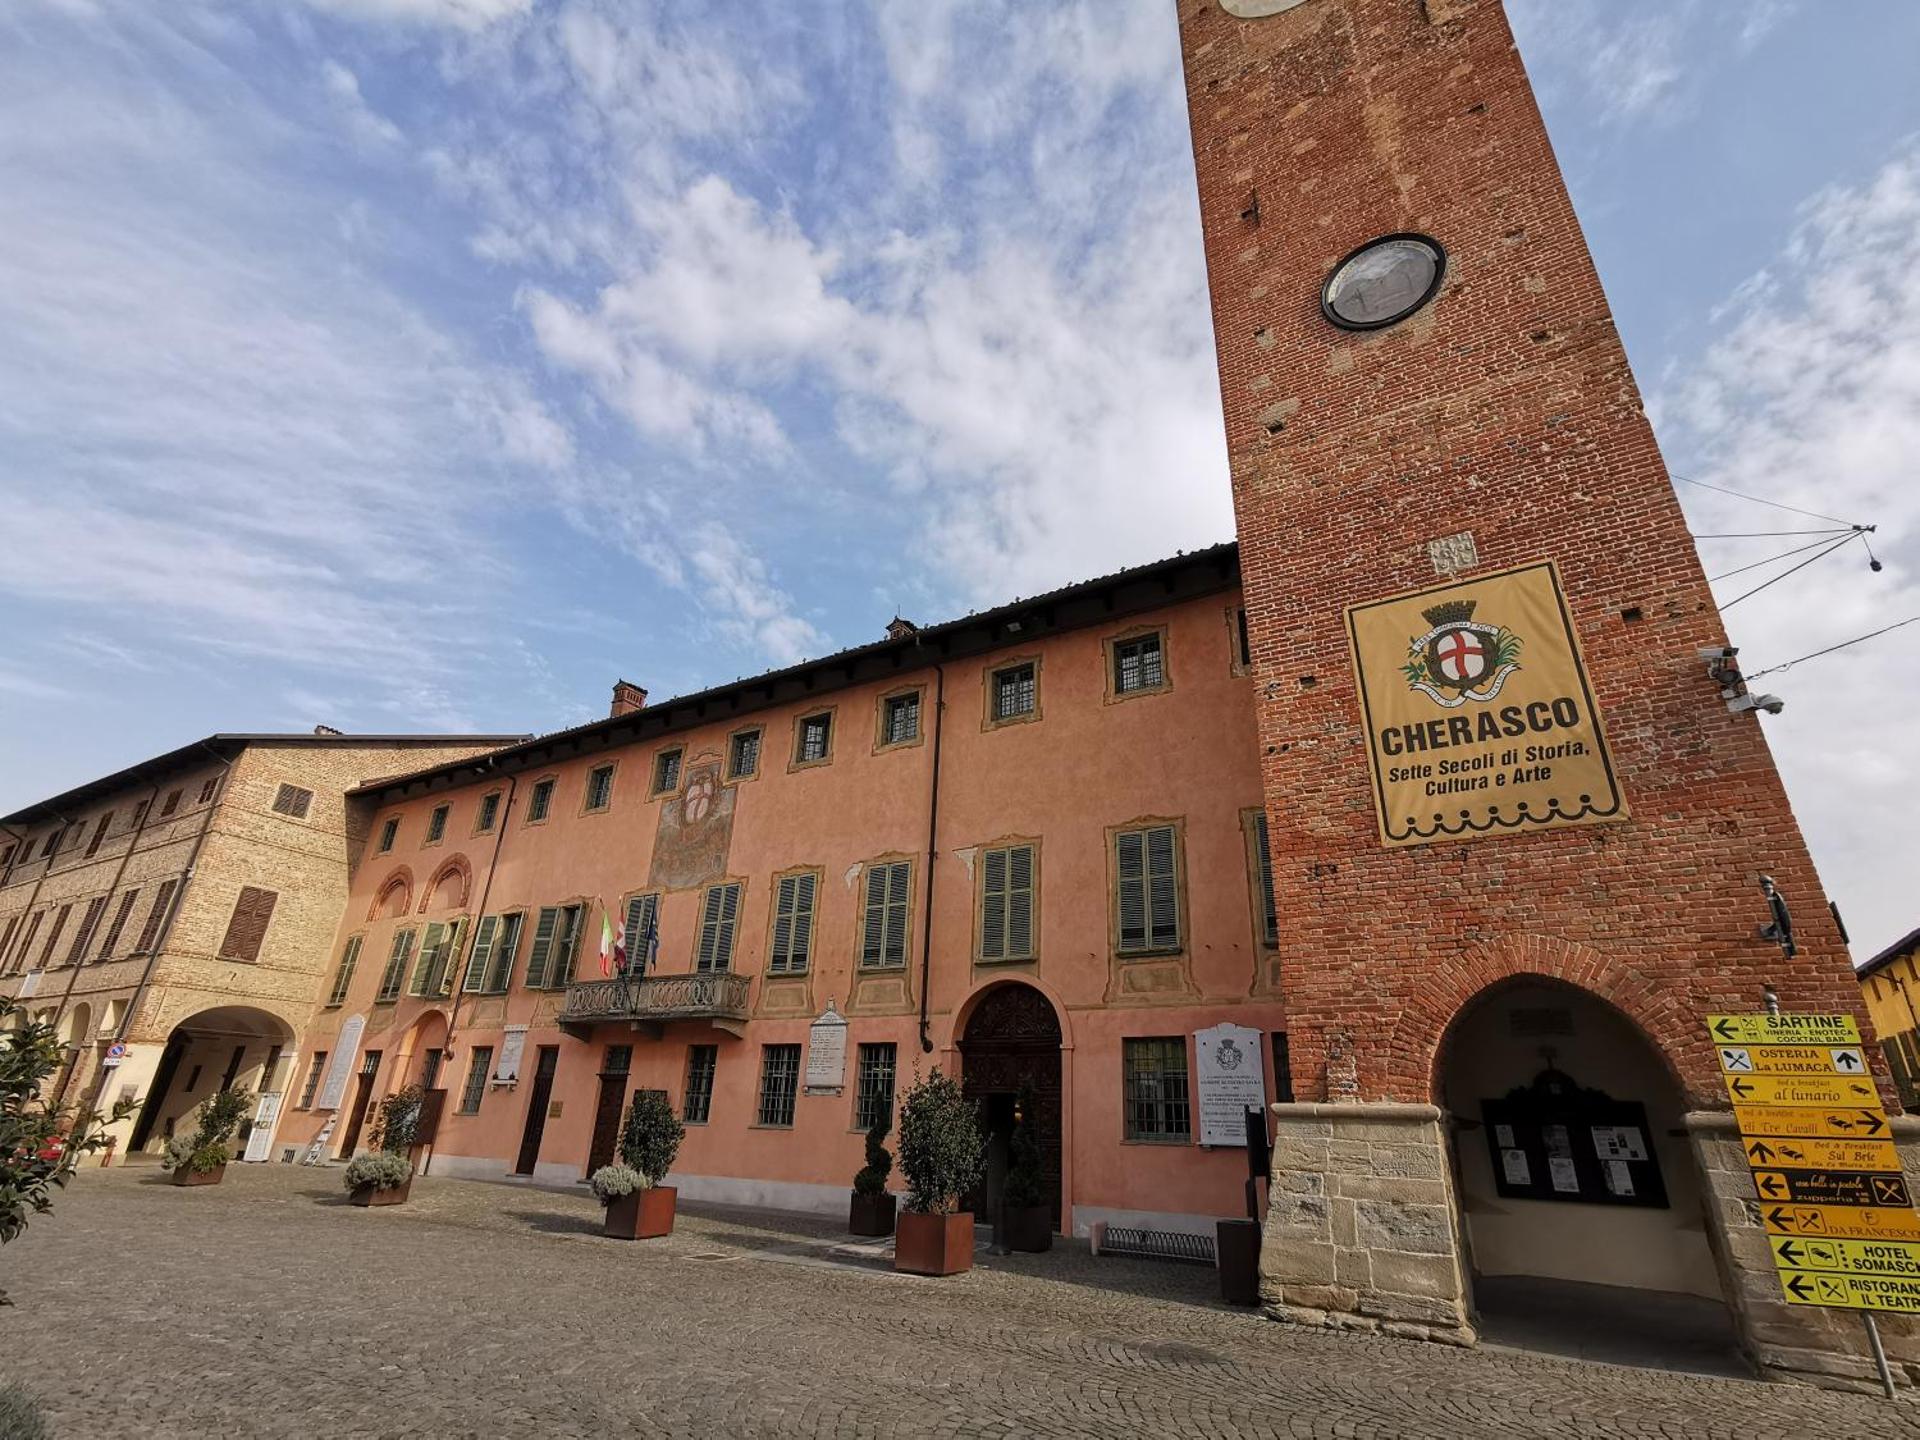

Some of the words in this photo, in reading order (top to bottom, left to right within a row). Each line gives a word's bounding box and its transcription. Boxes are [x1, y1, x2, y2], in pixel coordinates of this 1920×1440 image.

[1381, 697, 1580, 756] CHERASCO
[1389, 763, 1432, 783] Sette
[1438, 752, 1494, 776] Secoli
[1501, 748, 1519, 766] di
[1526, 740, 1590, 762] Storia,
[1425, 774, 1488, 797] Cultura
[1496, 772, 1506, 786] e
[1513, 765, 1551, 785] Arte
[1766, 1016, 1845, 1028] SARTINE
[1759, 1049, 1819, 1058] OSTERIA
[1775, 1063, 1833, 1073] LUMACA
[1774, 1088, 1788, 1100] al
[1791, 1088, 1840, 1101] lunario
[1828, 1150, 1846, 1161] Sul
[1829, 1226, 1847, 1235] DA
[1864, 1246, 1913, 1259] HOTEL
[1861, 1293, 1875, 1305] IL
